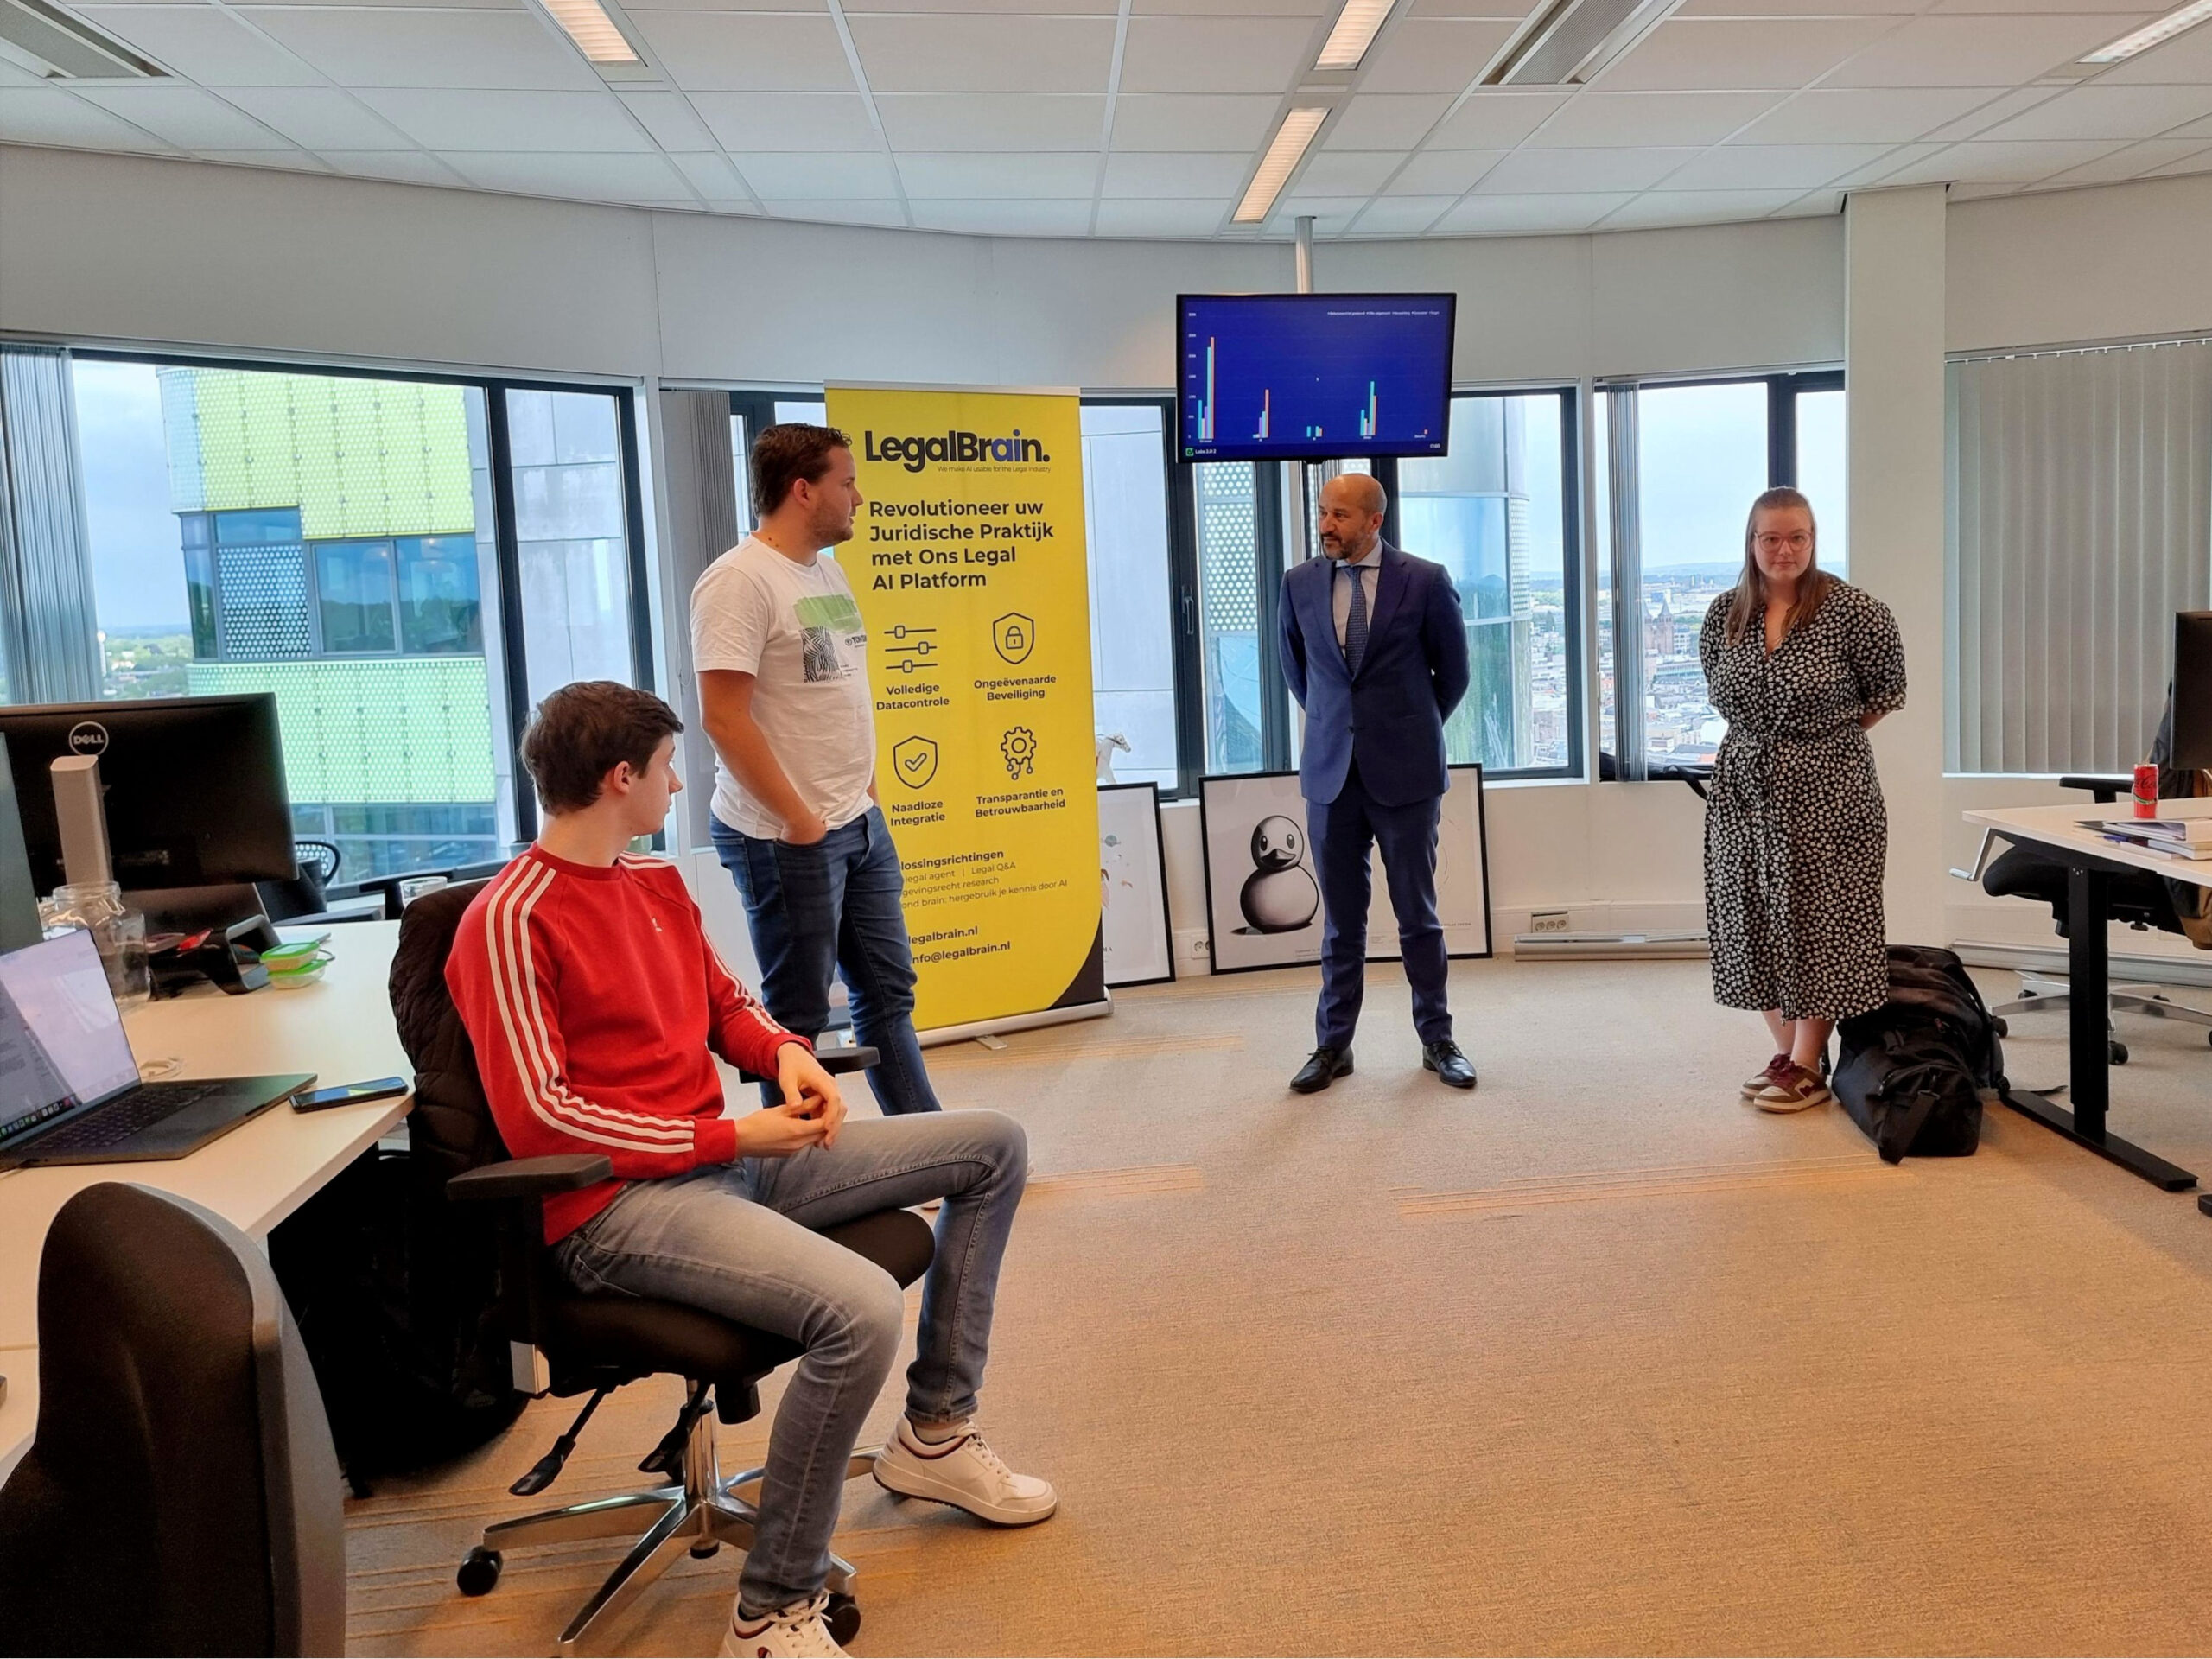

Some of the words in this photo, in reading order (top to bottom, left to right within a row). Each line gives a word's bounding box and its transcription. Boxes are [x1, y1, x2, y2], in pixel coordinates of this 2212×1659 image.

[865, 429, 1050, 473] LegalBrain.
[869, 499, 1009, 518] Revolutioneer
[1015, 502, 1043, 515] uw
[869, 524, 974, 542] Juridische
[980, 522, 1054, 542] Praktijk
[872, 550, 912, 566] met
[918, 549, 958, 564] Ons
[964, 547, 1016, 566] Legal
[872, 575, 893, 591] AI
[900, 573, 987, 589] Platform
[886, 683, 940, 696] Volledige
[974, 675, 1057, 690] Ongeëvenaarde
[876, 697, 950, 710] Datacontrole
[987, 689, 1046, 702] Beveiliging
[73, 734, 105, 745] DELL
[976, 788, 1048, 805] Transparantie
[1050, 788, 1064, 797] en
[892, 800, 944, 814] Naadloze
[976, 799, 1066, 817] Betrouwbaarheid
[890, 812, 945, 827] Integratie
[901, 850, 1004, 871] lossingsrichtingen
[905, 873, 927, 884] legal
[929, 870, 955, 881] agent
[971, 865, 995, 875] Legal
[996, 862, 1016, 872] Q&A
[902, 900, 919, 909] ond
[949, 889, 997, 902] hergebruik
[999, 887, 1007, 897] je
[1008, 884, 1037, 894] kennis
[1039, 881, 1057, 891] door
[903, 882, 960, 898] gevingsrecht
[963, 876, 1000, 888] research
[912, 941, 1011, 964] nfo@legalbrain.nl
